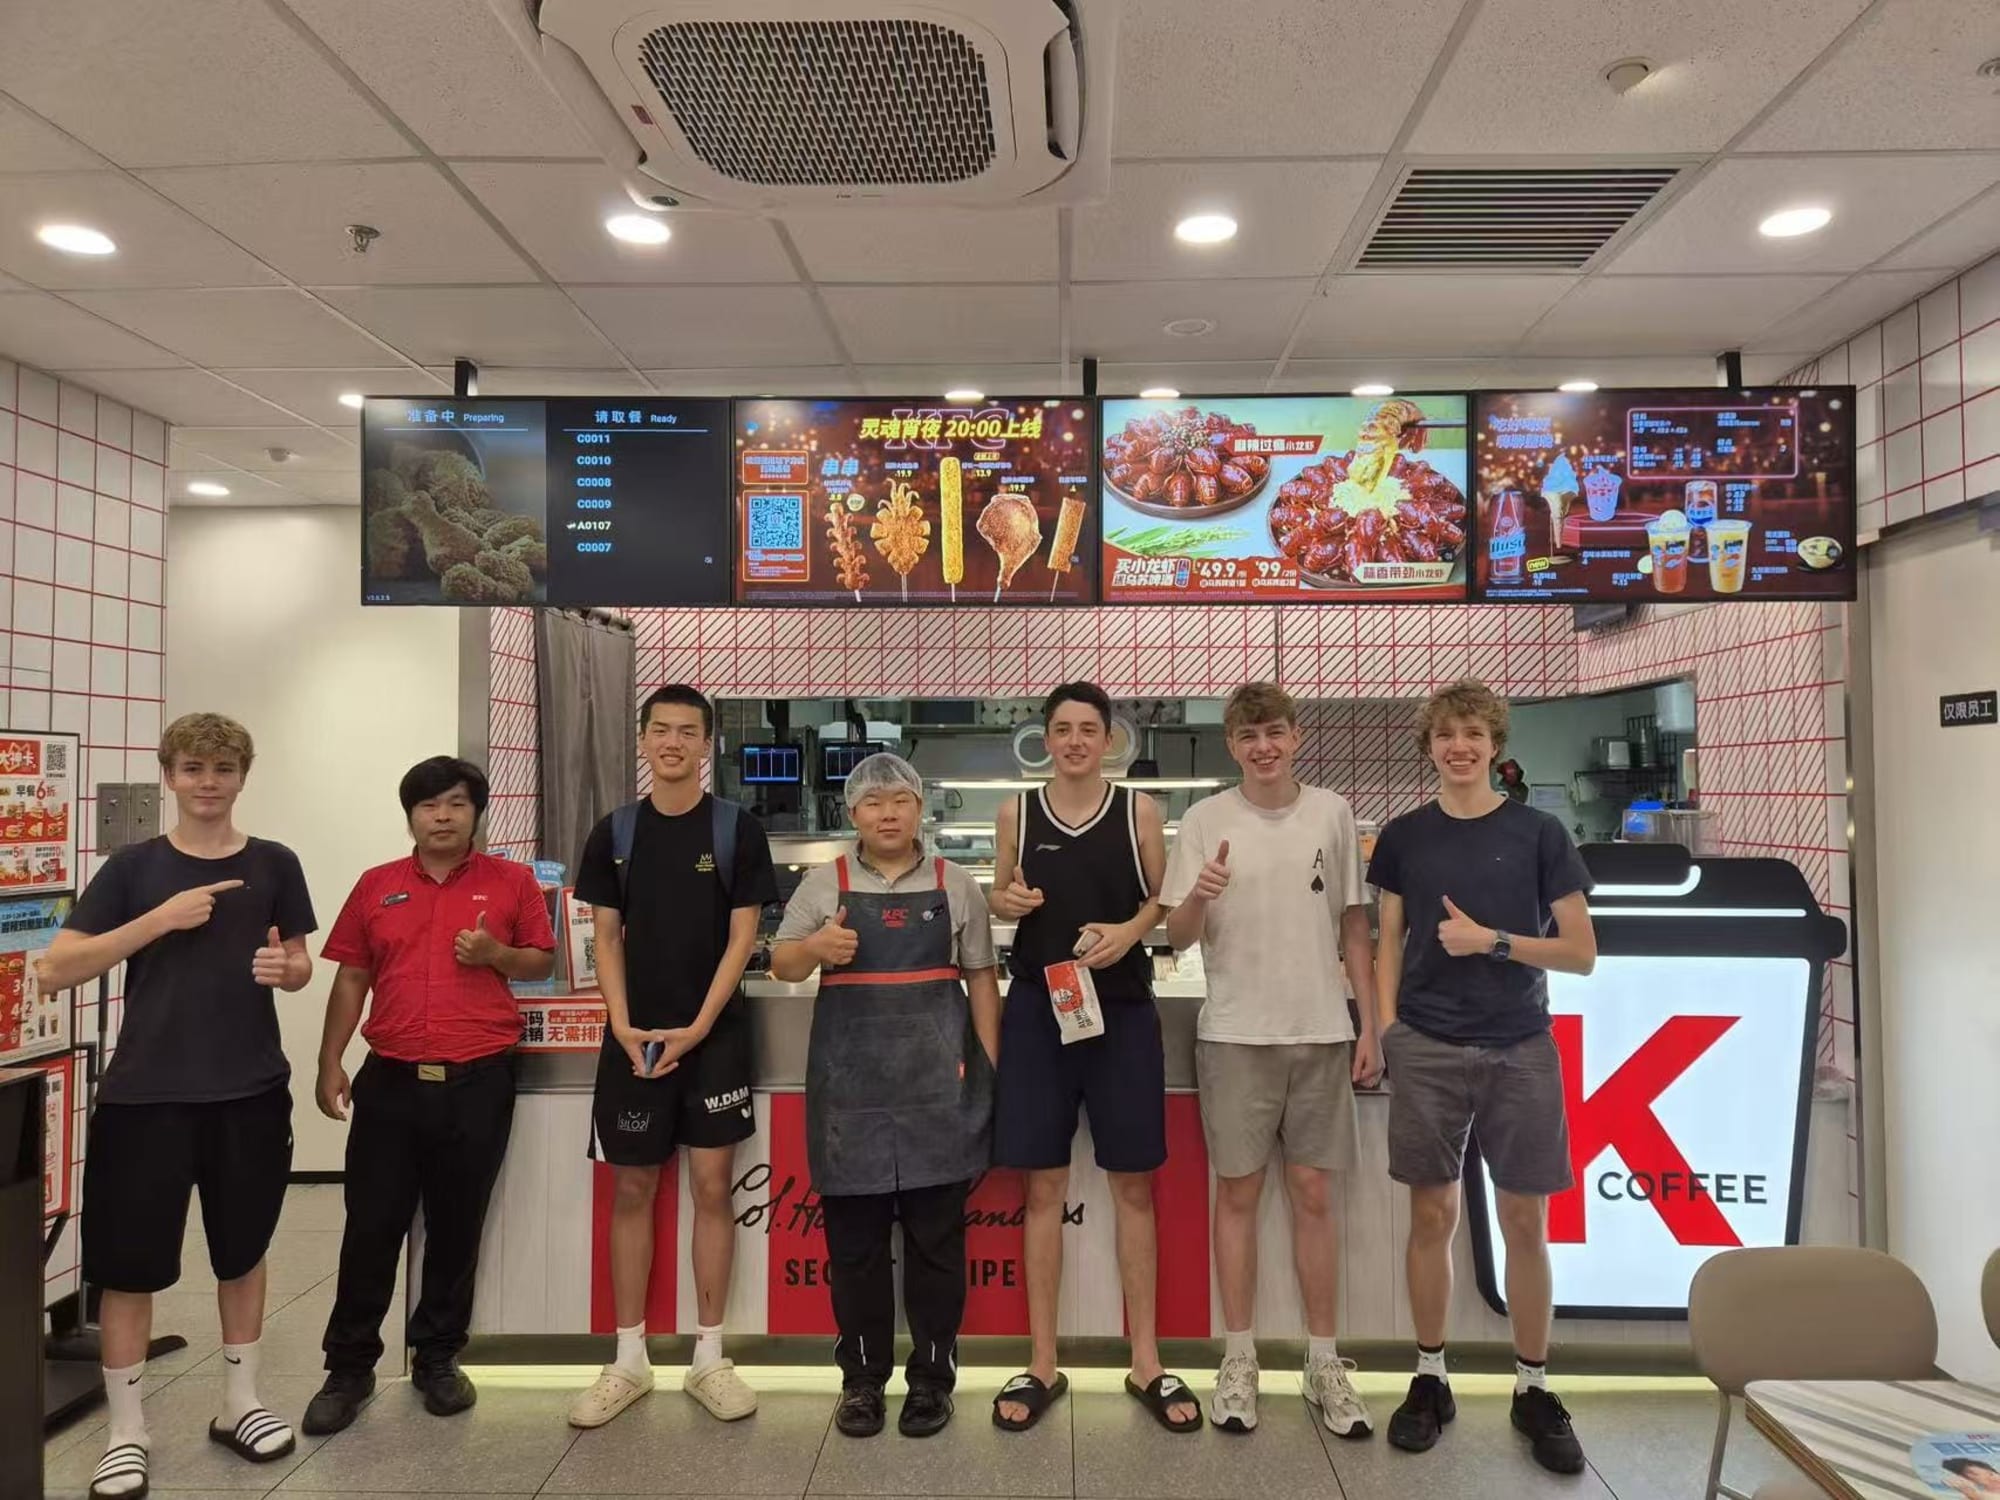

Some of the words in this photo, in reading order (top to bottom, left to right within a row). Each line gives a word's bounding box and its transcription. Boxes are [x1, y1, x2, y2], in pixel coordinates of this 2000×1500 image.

[407, 409, 455, 423] 准备中
[463, 413, 505, 425] Preparing
[594, 410, 642, 424] 请取餐
[650, 414, 677, 425] Ready
[860, 418, 942, 438] 灵魂宵夜
[577, 434, 611, 444] C0011
[577, 456, 612, 466] C0010
[577, 478, 612, 488] C0008
[577, 500, 612, 509] C0009
[577, 521, 612, 531] A0107
[577, 543, 612, 553] C0007
[1944, 699, 1993, 721] 仅限员工
[1312, 848, 1324, 869] A
[1547, 1014, 1742, 1247] K
[1597, 1170, 1768, 1205] COFFEE
